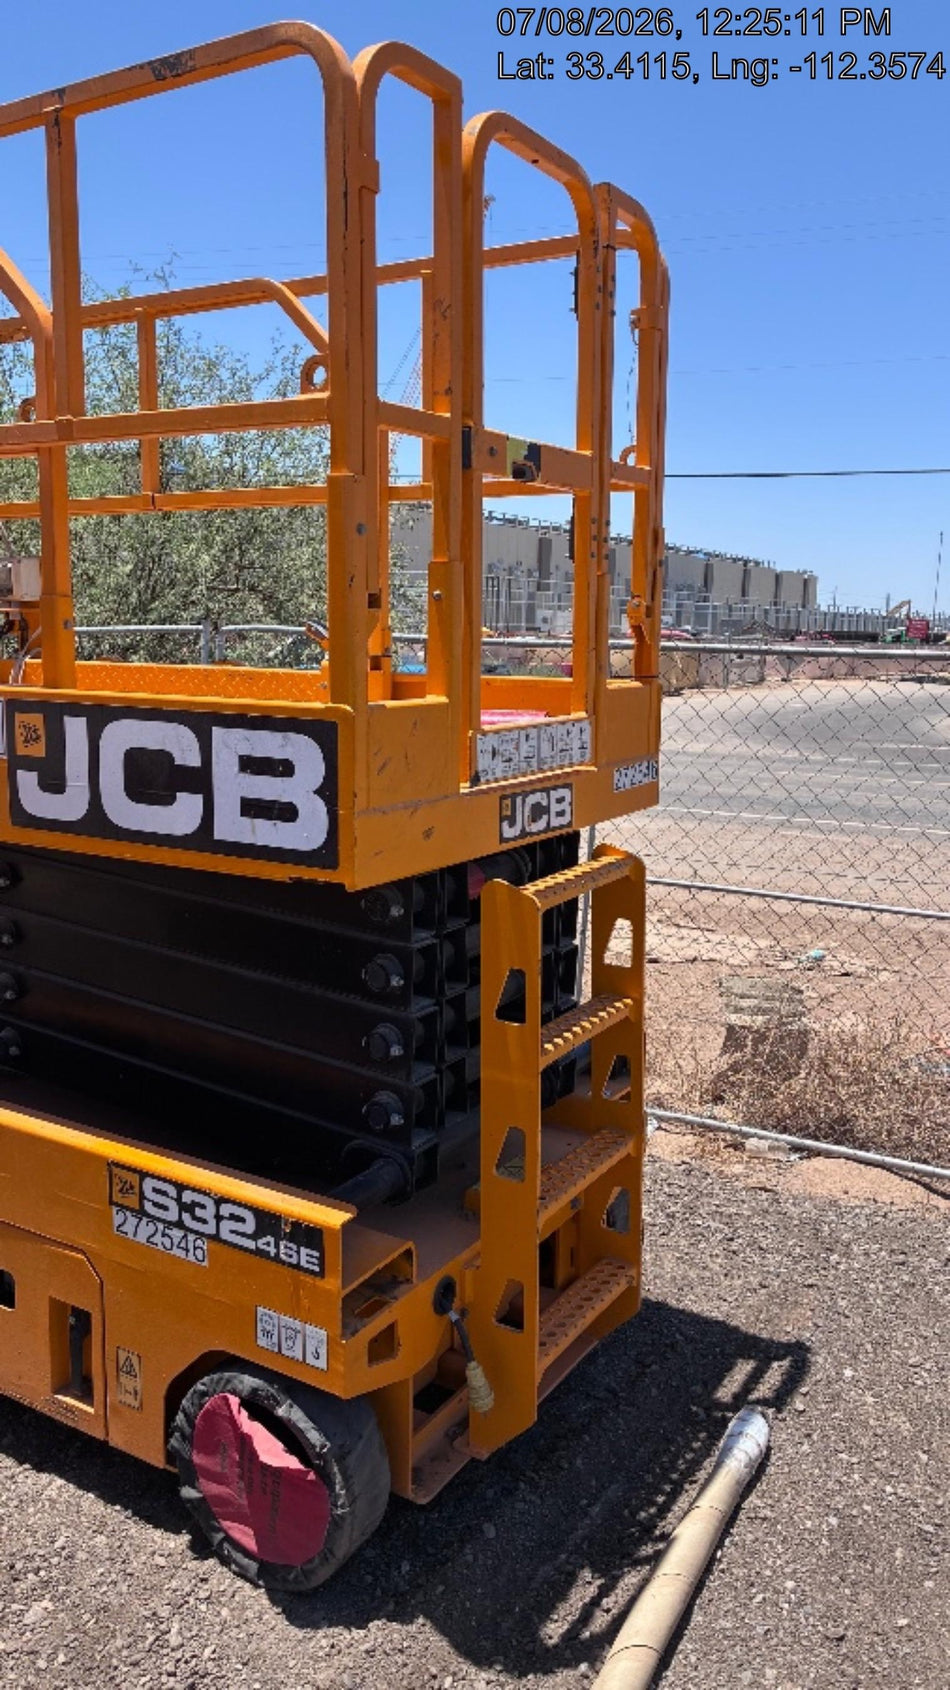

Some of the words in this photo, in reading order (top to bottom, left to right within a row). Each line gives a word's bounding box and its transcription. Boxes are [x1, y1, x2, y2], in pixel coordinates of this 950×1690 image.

[16, 715, 329, 851] JCB
[501, 787, 572, 839] JCB
[115, 1208, 207, 1266] 272546
